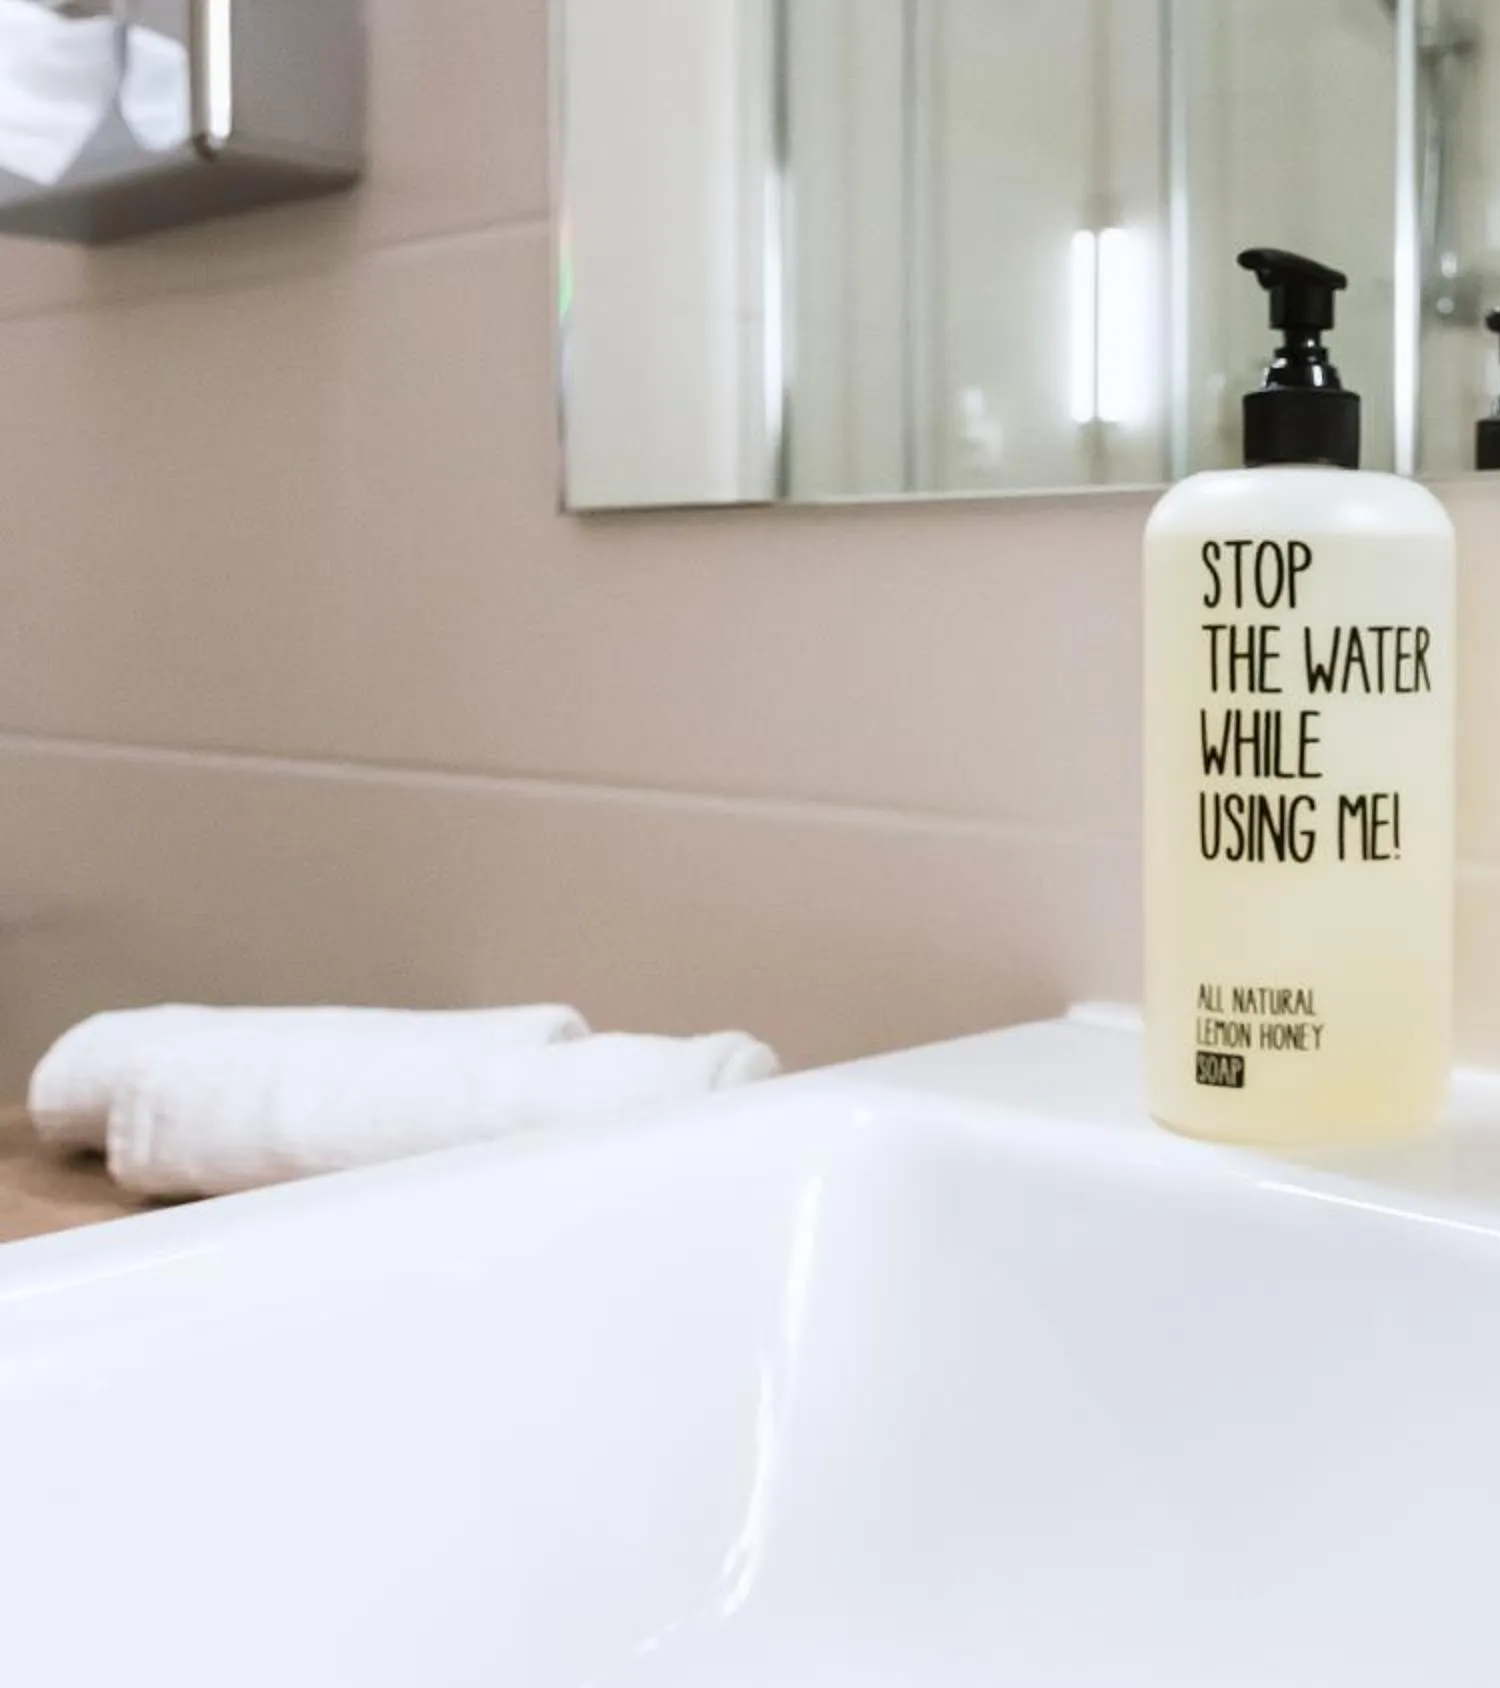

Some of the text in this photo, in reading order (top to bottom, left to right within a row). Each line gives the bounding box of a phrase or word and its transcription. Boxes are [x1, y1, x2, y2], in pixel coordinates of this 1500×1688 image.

[1202, 540, 1313, 609] STOP
[1202, 624, 1431, 694] THE WATER
[1200, 709, 1322, 778] WHILE
[1200, 791, 1402, 863] USING ME!
[1196, 1016, 1326, 1051] LEMON HONEY
[1197, 983, 1317, 1016] ALL NATURAL
[1197, 1053, 1243, 1086] SOAP
